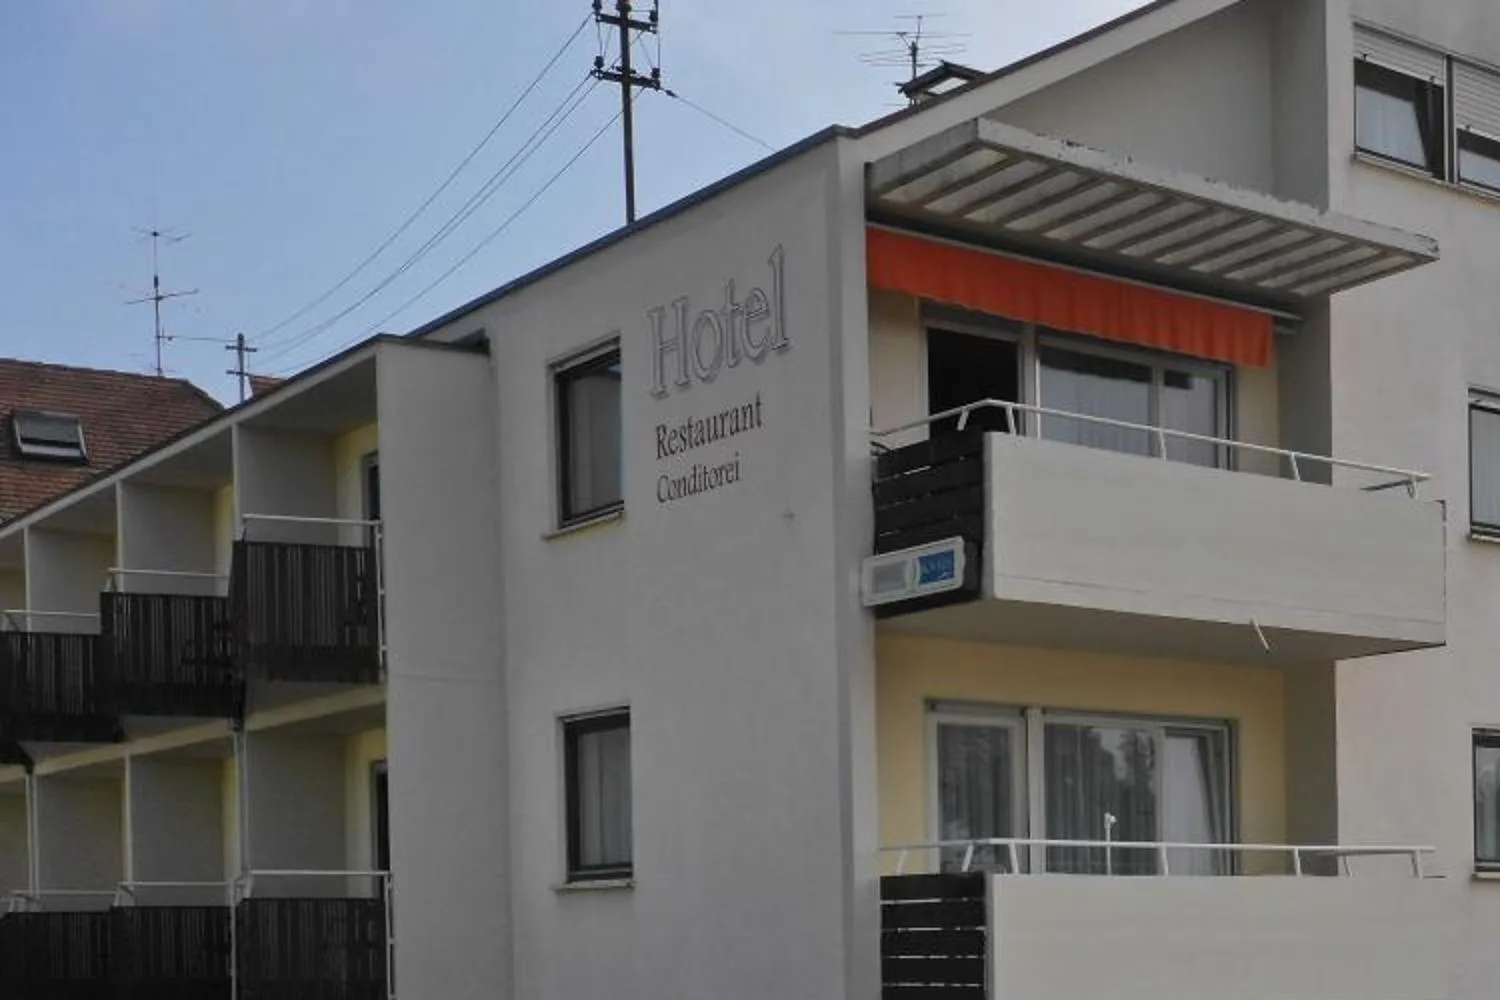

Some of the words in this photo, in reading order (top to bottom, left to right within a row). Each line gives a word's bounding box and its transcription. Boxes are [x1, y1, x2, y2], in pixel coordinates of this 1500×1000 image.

[647, 243, 793, 400] Hotel
[655, 392, 764, 460] Restaurant
[656, 451, 741, 503] Conditorei
